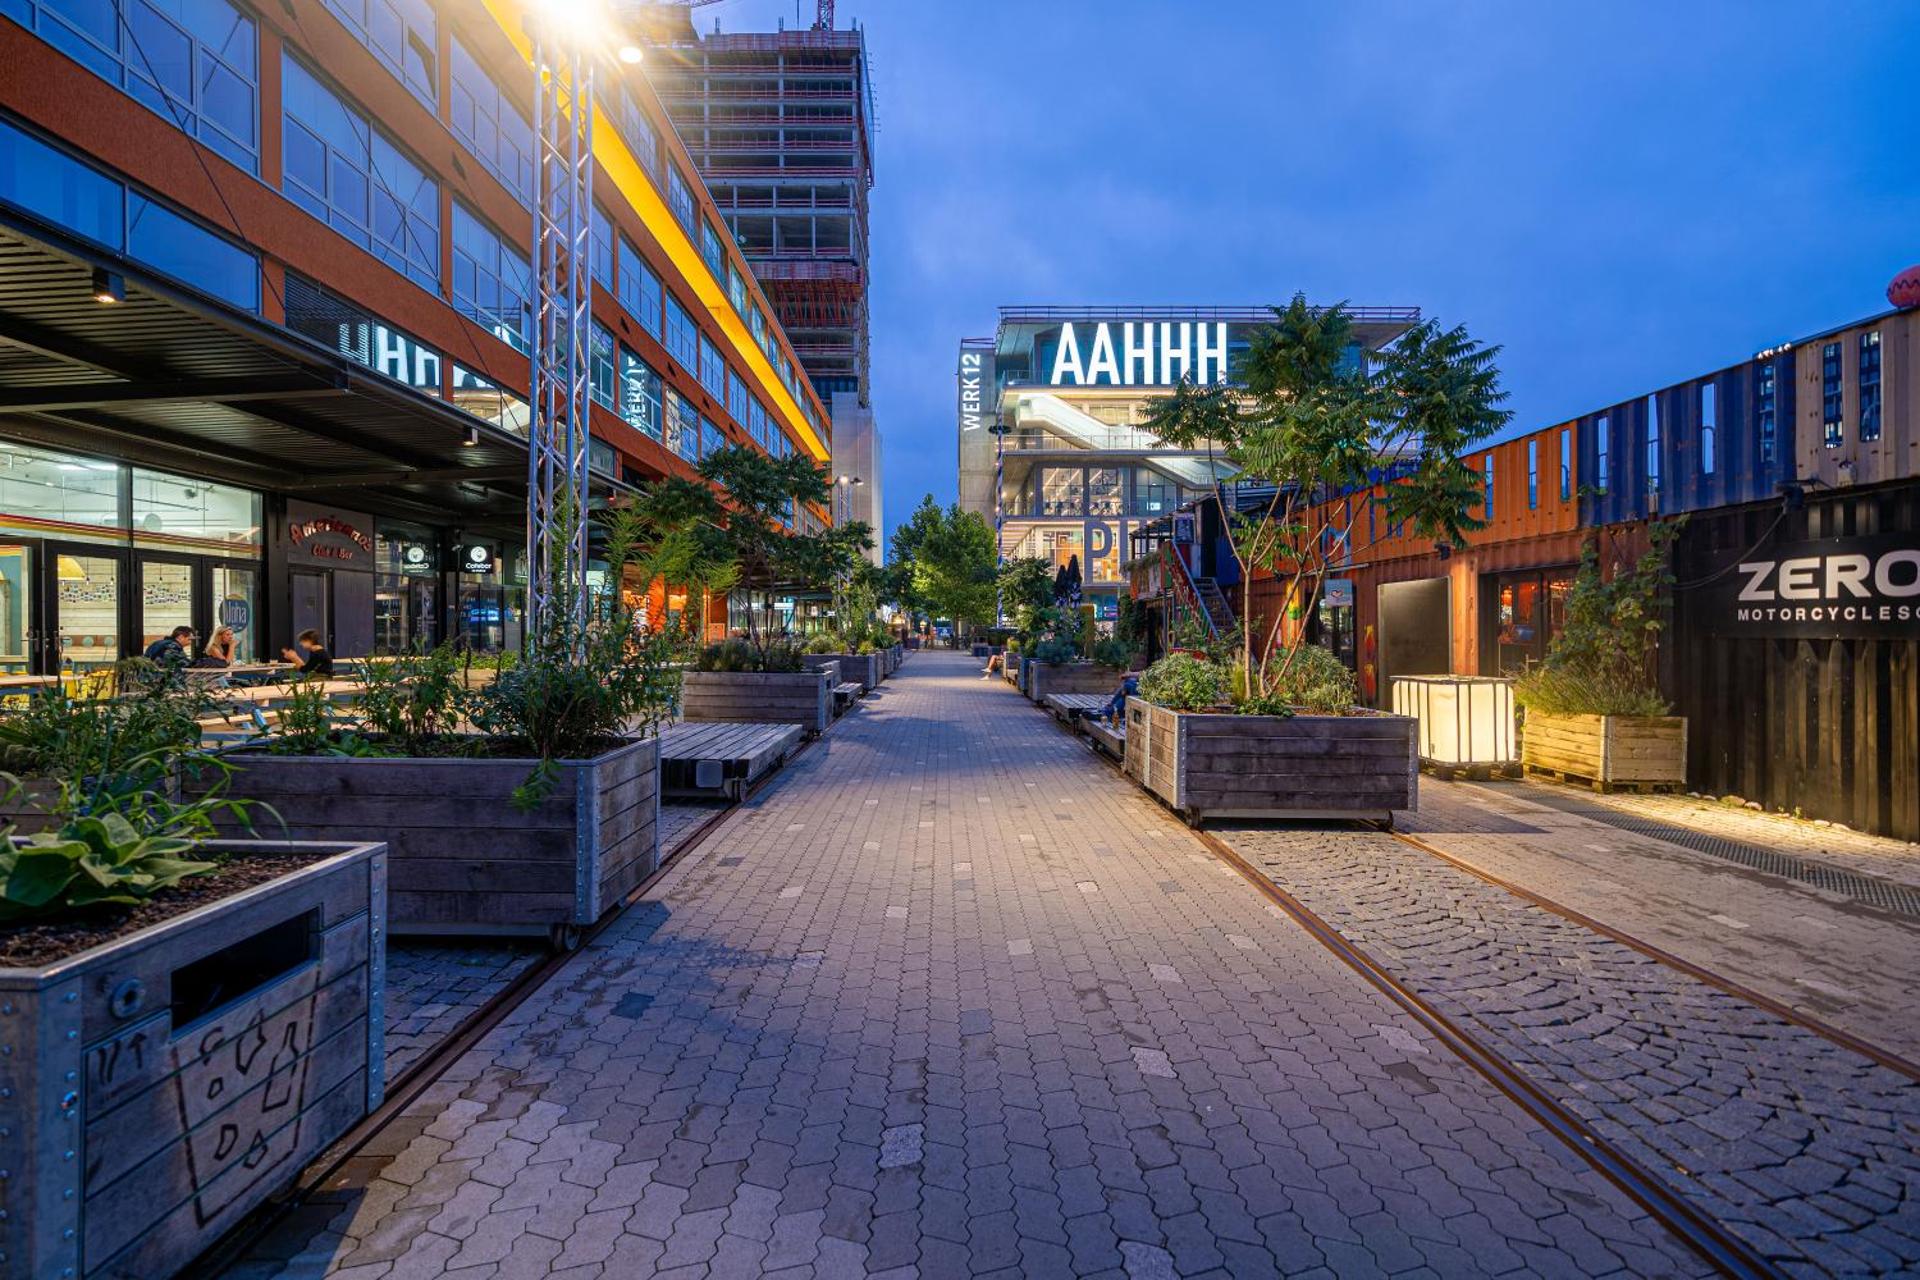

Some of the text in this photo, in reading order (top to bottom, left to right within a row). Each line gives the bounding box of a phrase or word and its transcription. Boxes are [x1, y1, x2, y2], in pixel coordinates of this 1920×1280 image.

[1050, 322, 1228, 385] AAHHH
[1738, 550, 1920, 601] ZERO
[1737, 606, 1911, 622] MOTORCYCLES
